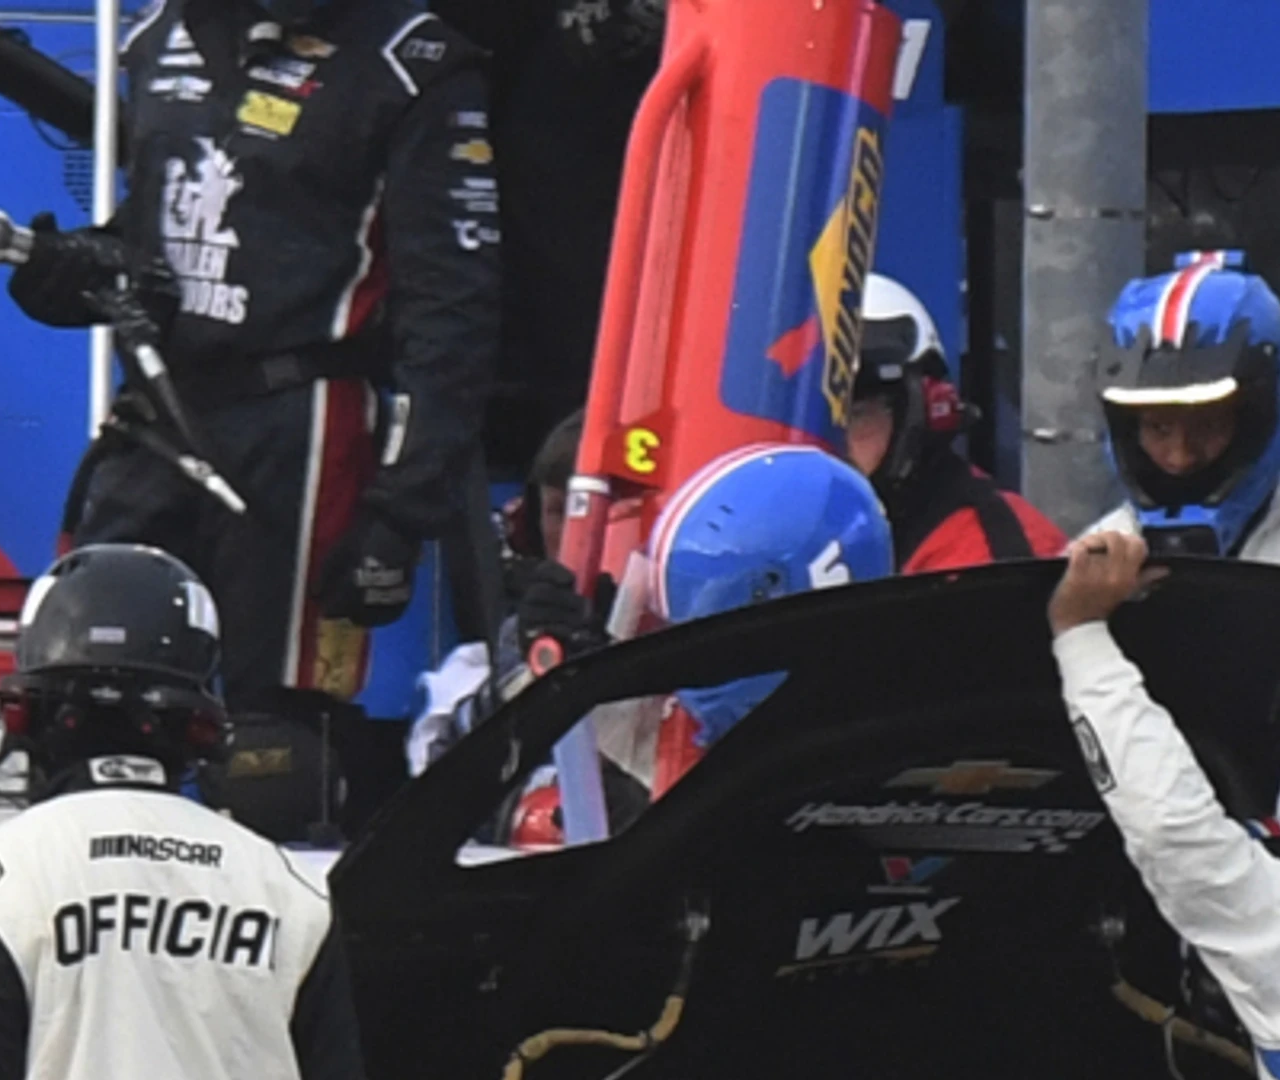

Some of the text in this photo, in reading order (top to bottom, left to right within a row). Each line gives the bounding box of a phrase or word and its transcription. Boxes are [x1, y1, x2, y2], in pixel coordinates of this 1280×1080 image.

[127, 834, 223, 868] NASCAR
[54, 892, 281, 971] OFFICIA
[795, 896, 962, 960] WIX
